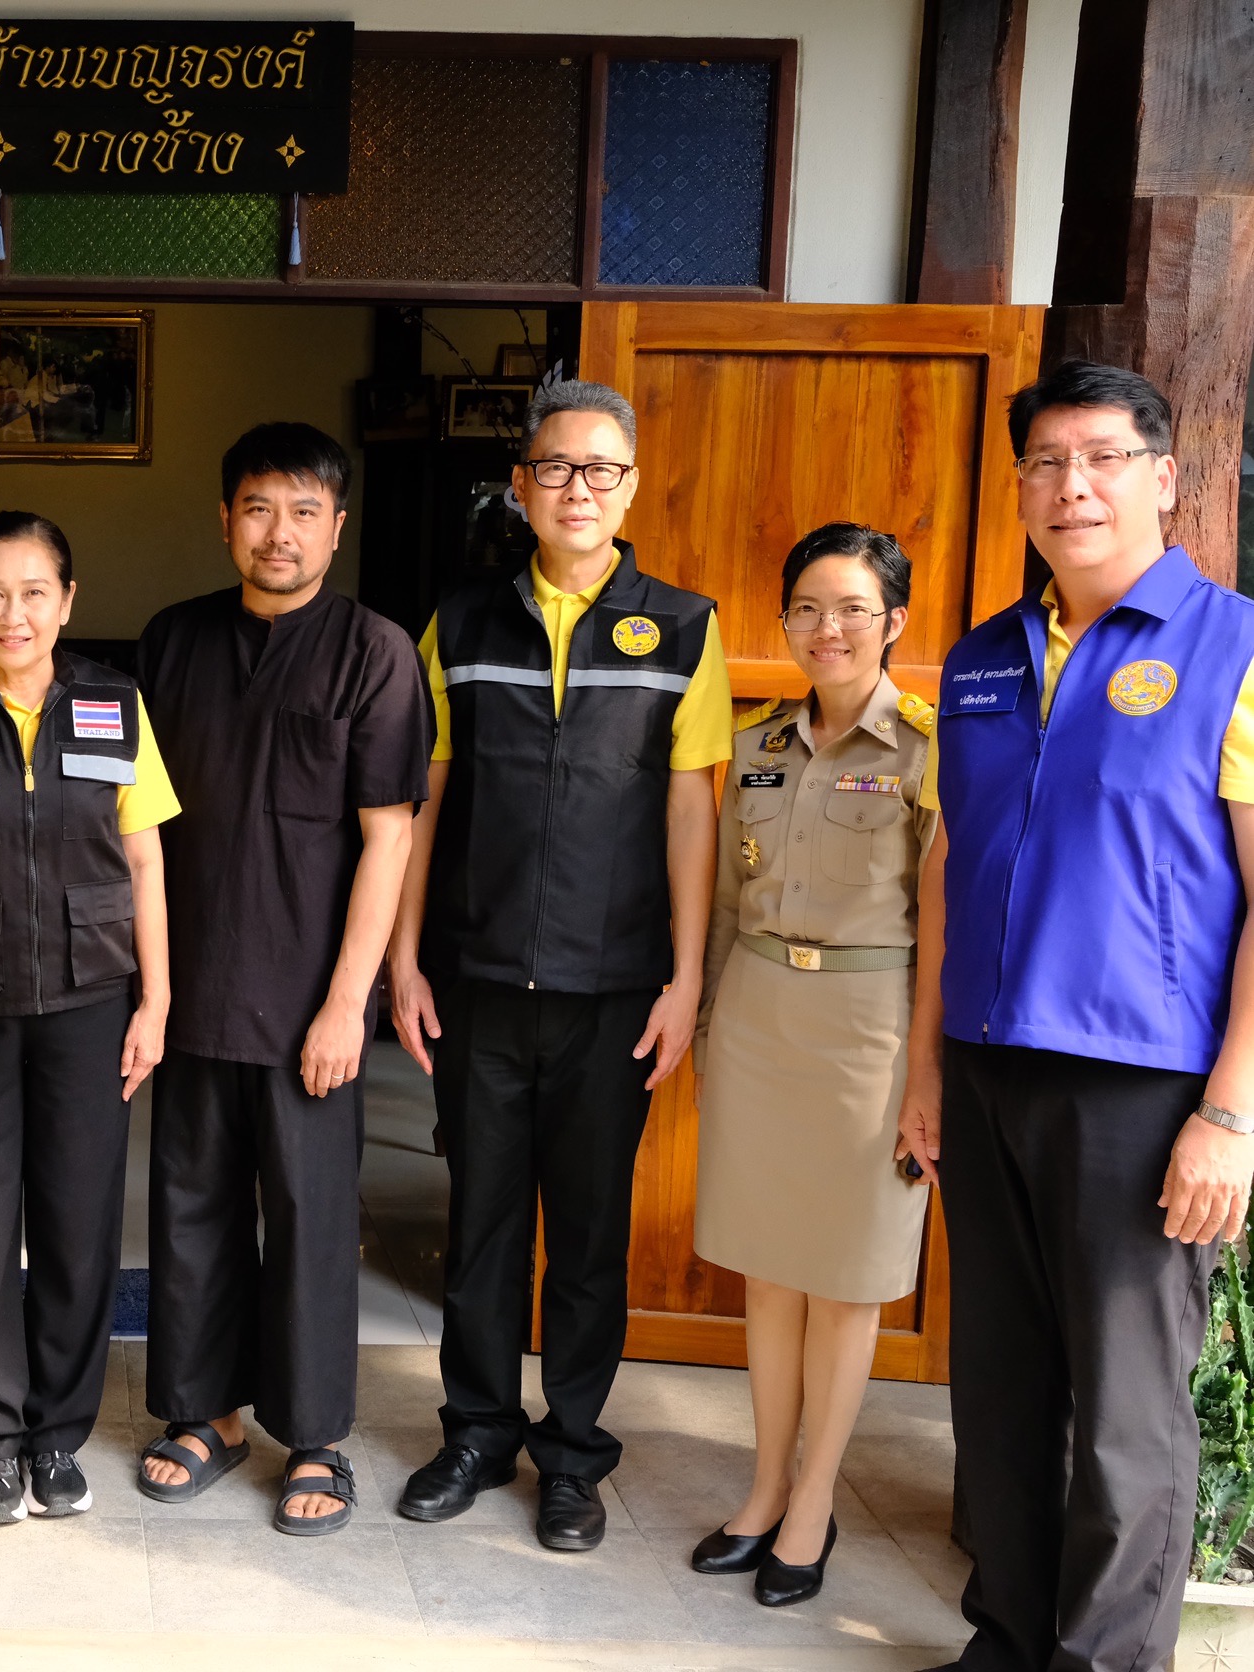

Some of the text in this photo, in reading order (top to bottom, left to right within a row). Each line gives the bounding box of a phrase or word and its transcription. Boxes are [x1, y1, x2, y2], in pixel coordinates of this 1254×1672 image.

[52, 109, 246, 174] บางช้าง
[959, 693, 998, 705] ปลัดจังหวัด
[77, 728, 121, 737] THAILAND
